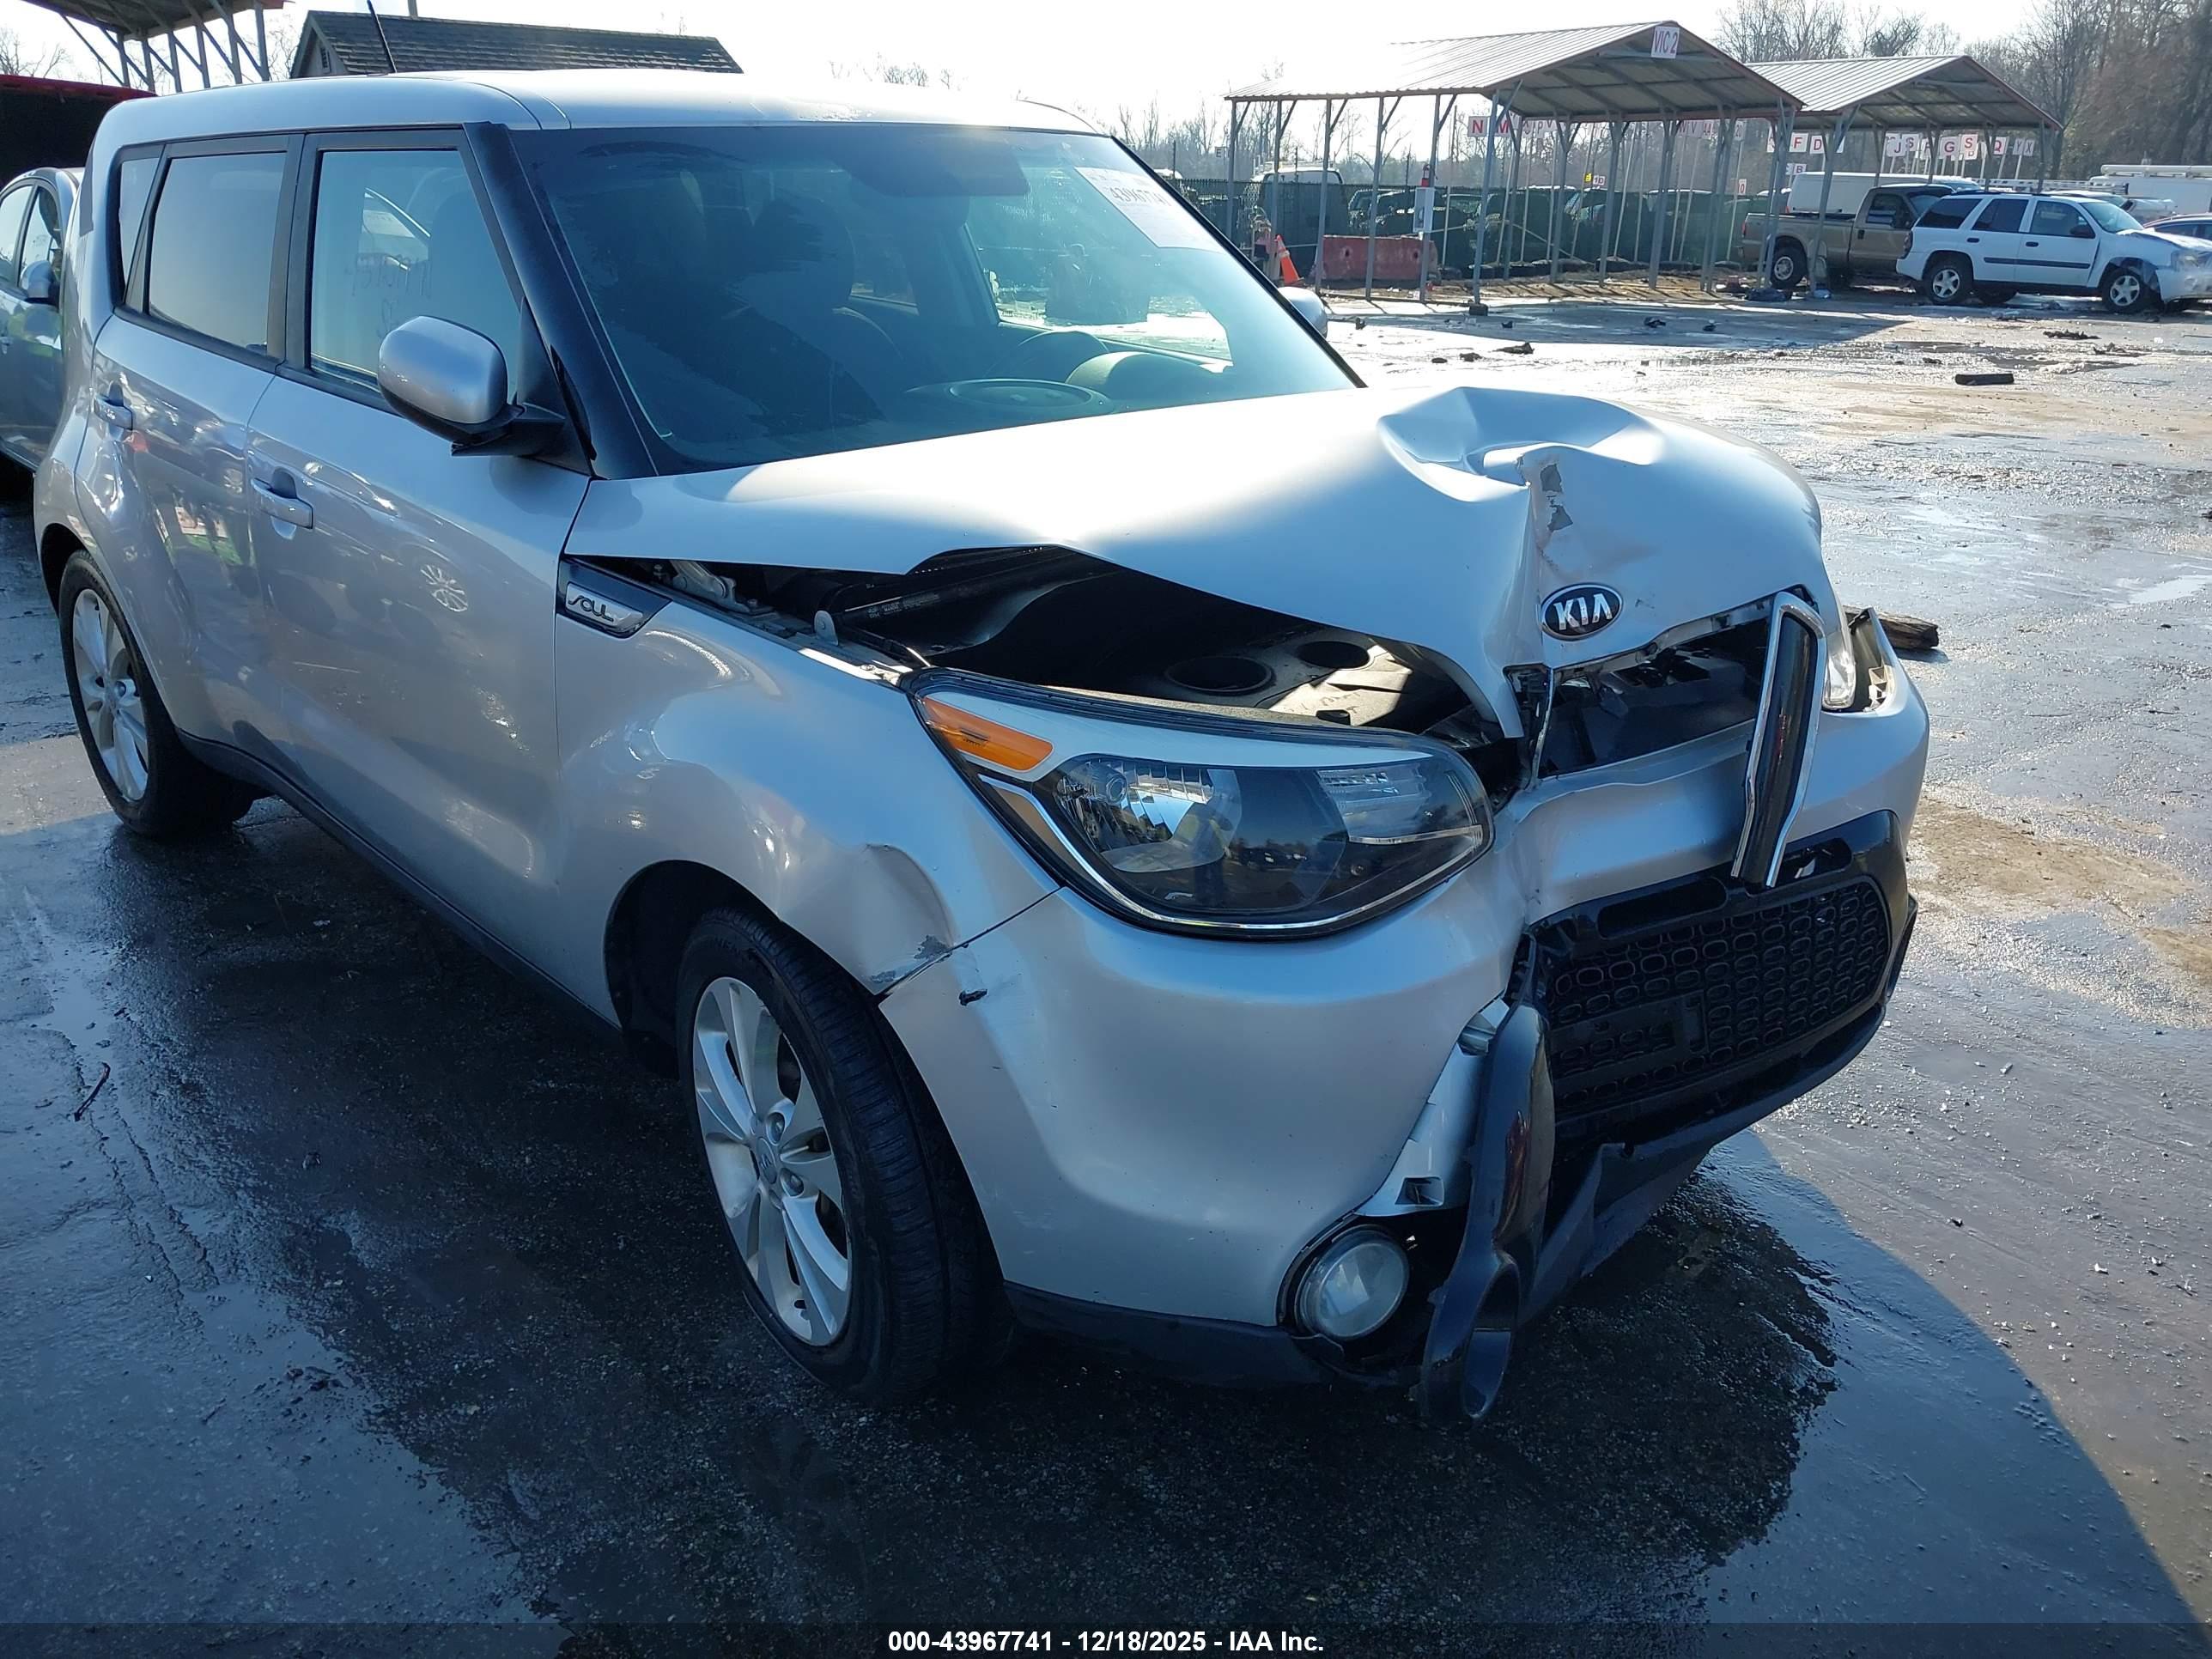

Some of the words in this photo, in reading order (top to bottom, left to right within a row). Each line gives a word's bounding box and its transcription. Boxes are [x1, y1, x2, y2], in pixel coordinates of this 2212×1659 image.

[1669, 32, 1678, 54] 2
[1472, 119, 1484, 134] N
[1794, 137, 1803, 149] F
[1813, 138, 1822, 150] D
[1893, 142, 1901, 154] J
[1944, 141, 1955, 153] G
[1964, 137, 1973, 149] S
[568, 594, 615, 623] SOUL
[1553, 592, 1613, 631] KIA
